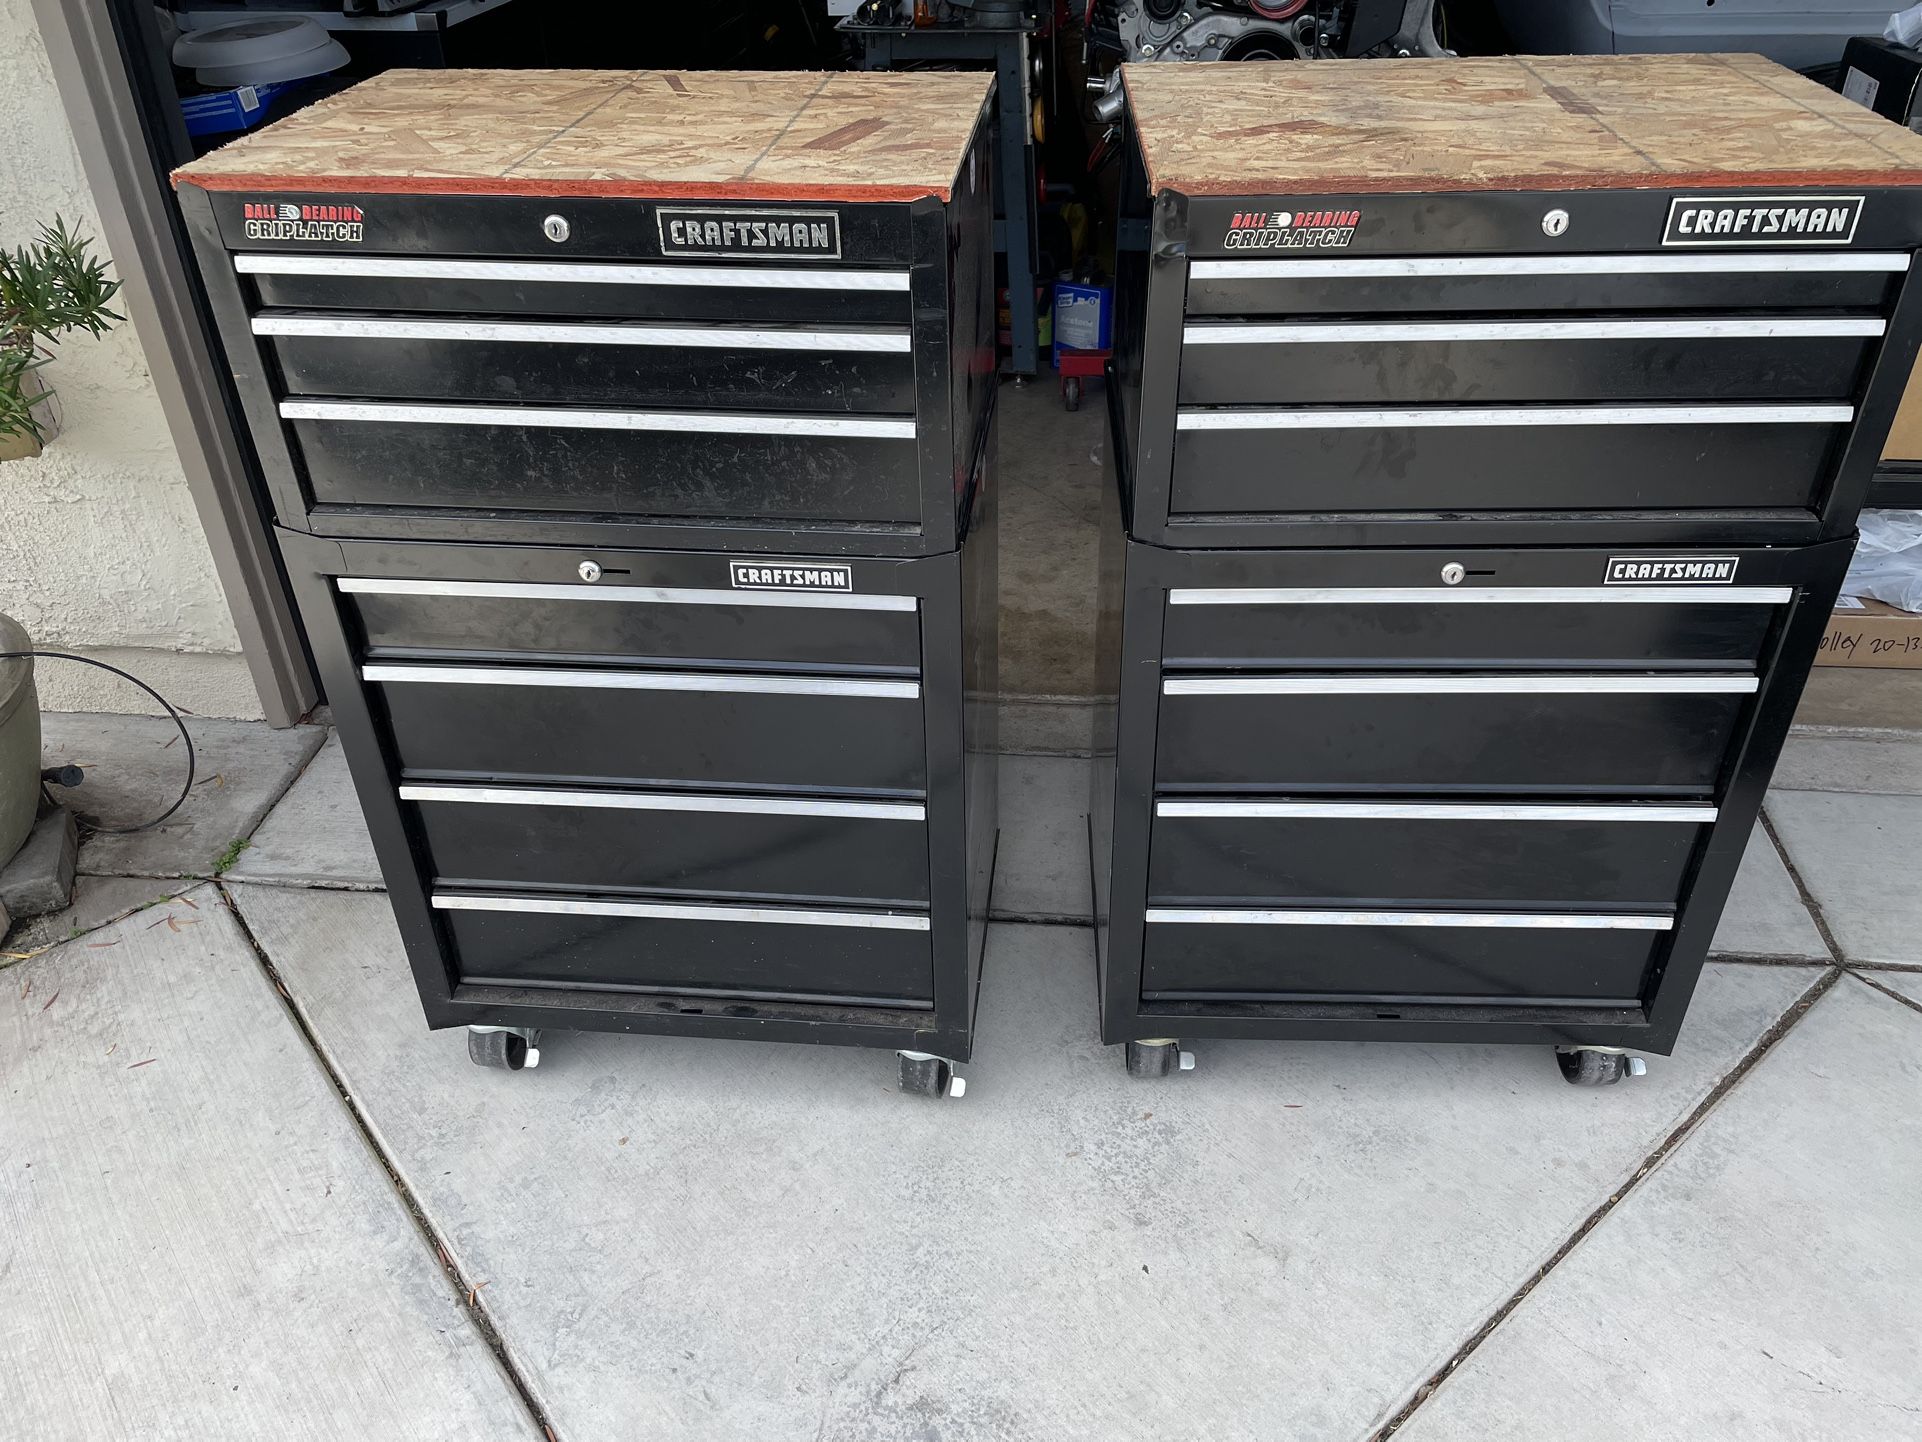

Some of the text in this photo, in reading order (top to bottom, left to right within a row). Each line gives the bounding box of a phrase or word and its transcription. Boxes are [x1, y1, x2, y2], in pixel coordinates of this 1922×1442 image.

[244, 203, 363, 221] BALL BEARING
[1230, 210, 1361, 228] BALL BEARING
[1678, 207, 1850, 234] CRAFTSMAN
[245, 219, 363, 242] GRIPLATCH
[669, 220, 829, 248] CRAFTSMAN
[1224, 228, 1355, 249] GRIPLATCH
[737, 568, 846, 586] CRAFTSMAN
[1613, 563, 1731, 579] CRAFTSMAN
[1819, 631, 1922, 660] olley 20-13
